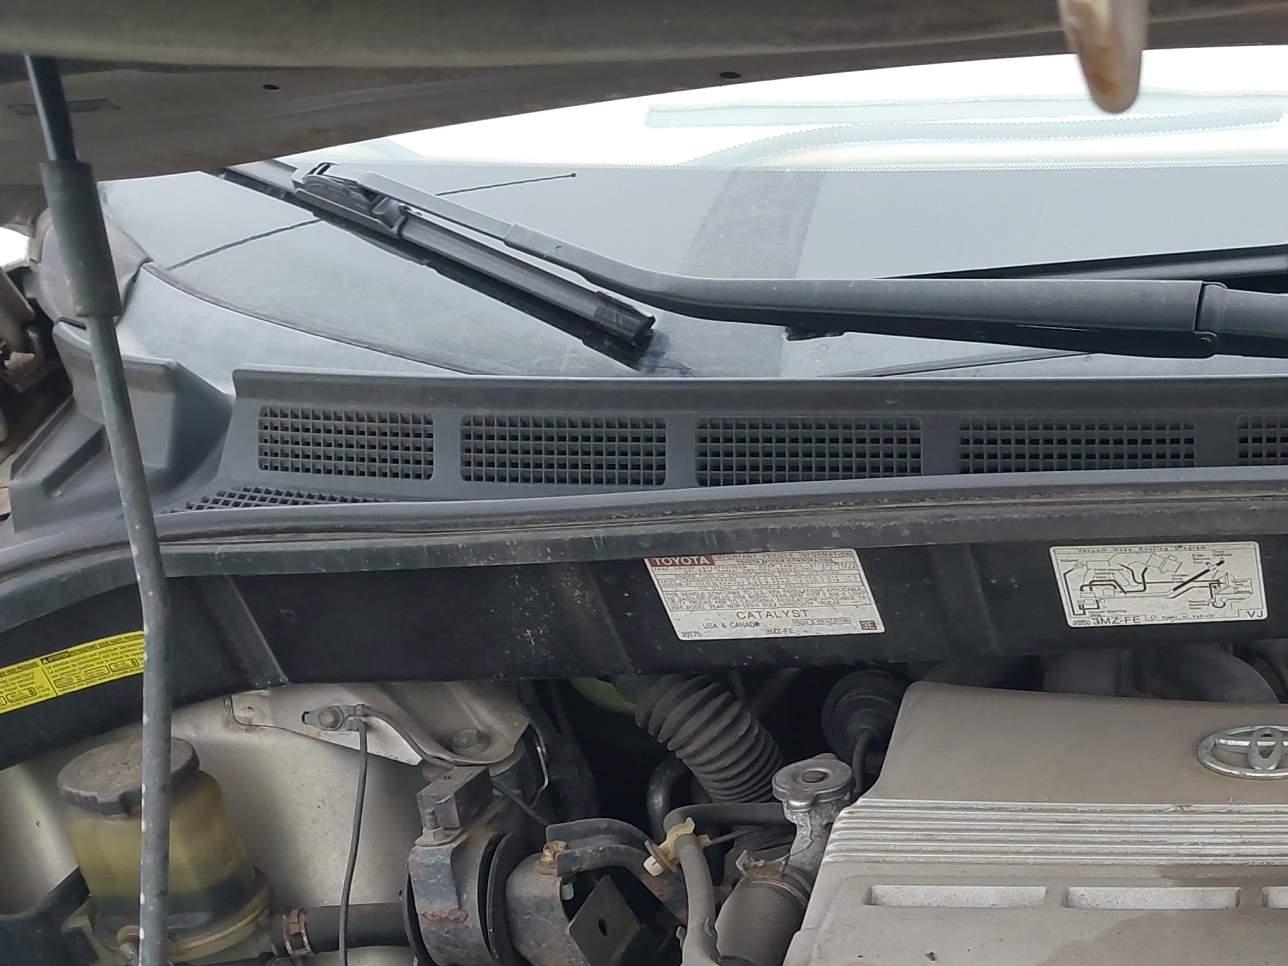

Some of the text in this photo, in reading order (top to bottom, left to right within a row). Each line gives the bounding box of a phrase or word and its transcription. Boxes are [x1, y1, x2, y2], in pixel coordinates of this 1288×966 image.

[654, 556, 711, 565] TOYOTA
[736, 609, 808, 619] CATALYST
[1091, 615, 1141, 625] 3MZ-FE
